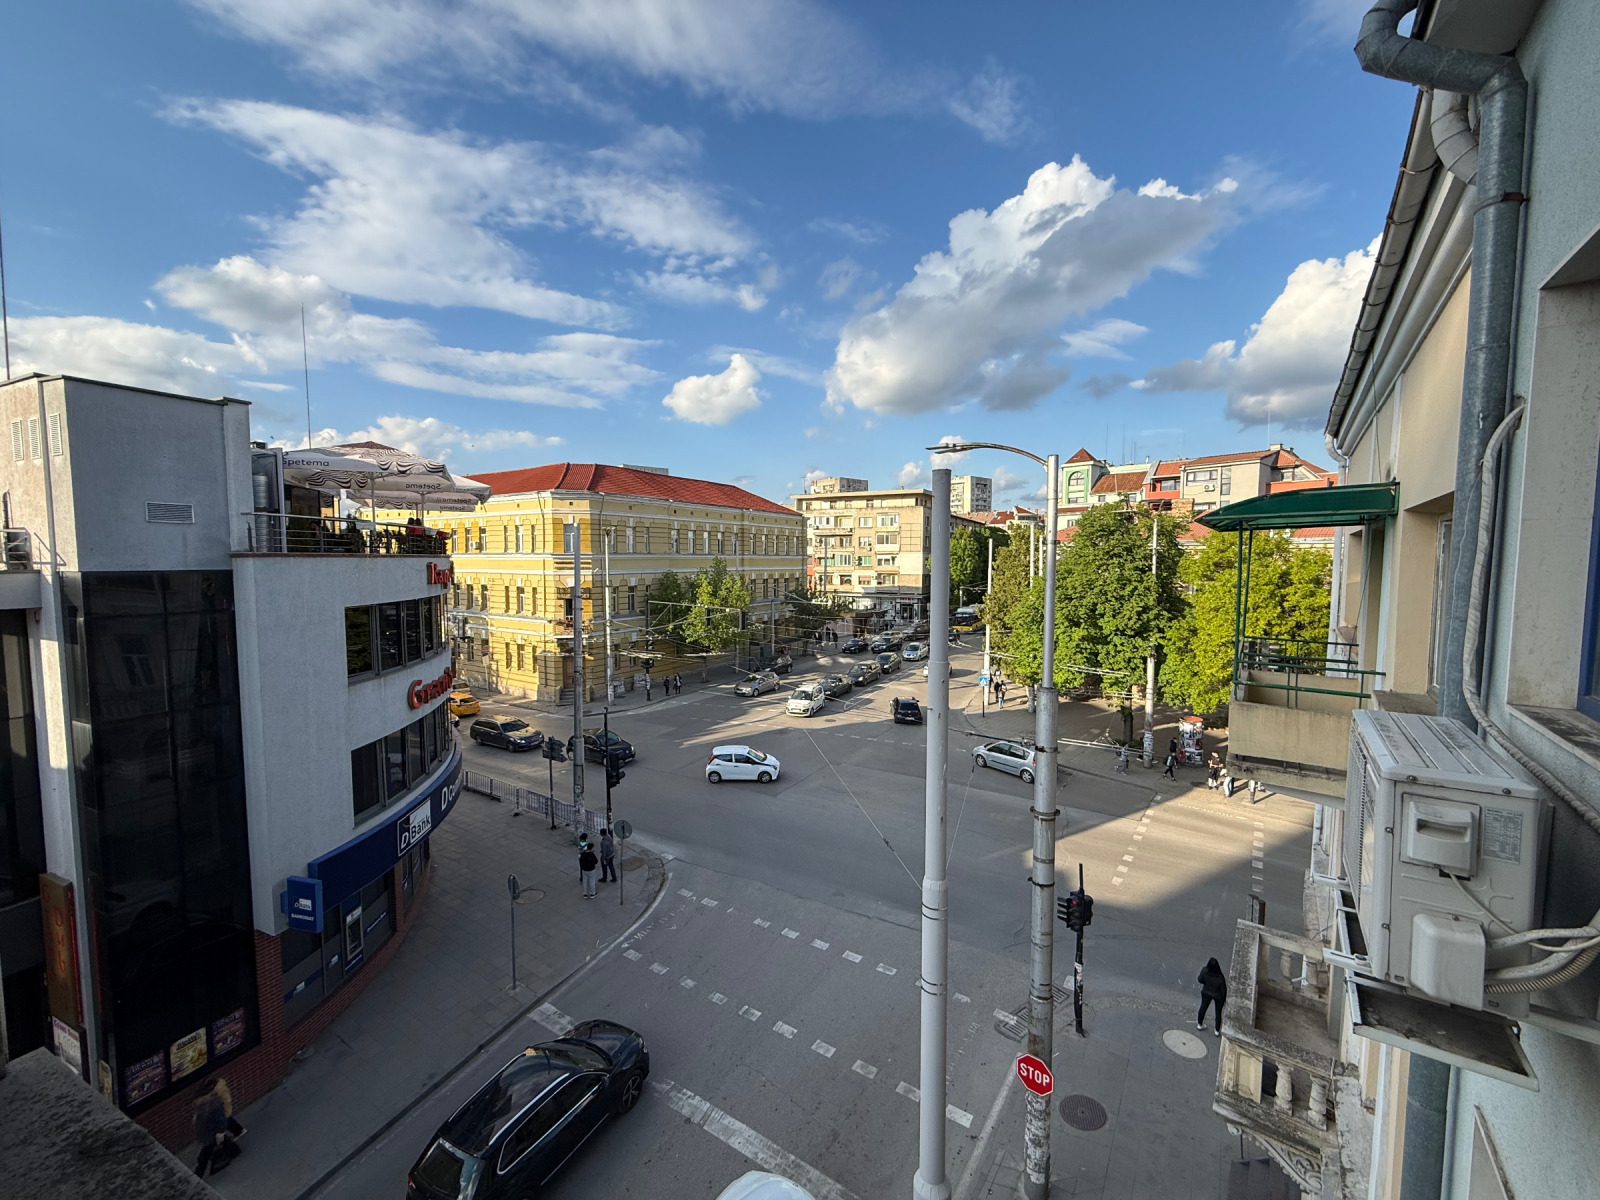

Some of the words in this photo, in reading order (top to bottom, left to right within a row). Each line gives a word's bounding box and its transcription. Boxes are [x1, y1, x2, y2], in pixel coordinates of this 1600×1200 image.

[283, 457, 329, 467] Spetema
[441, 786, 449, 811] D
[410, 814, 431, 839] Bank
[1019, 1062, 1050, 1087] STOP
